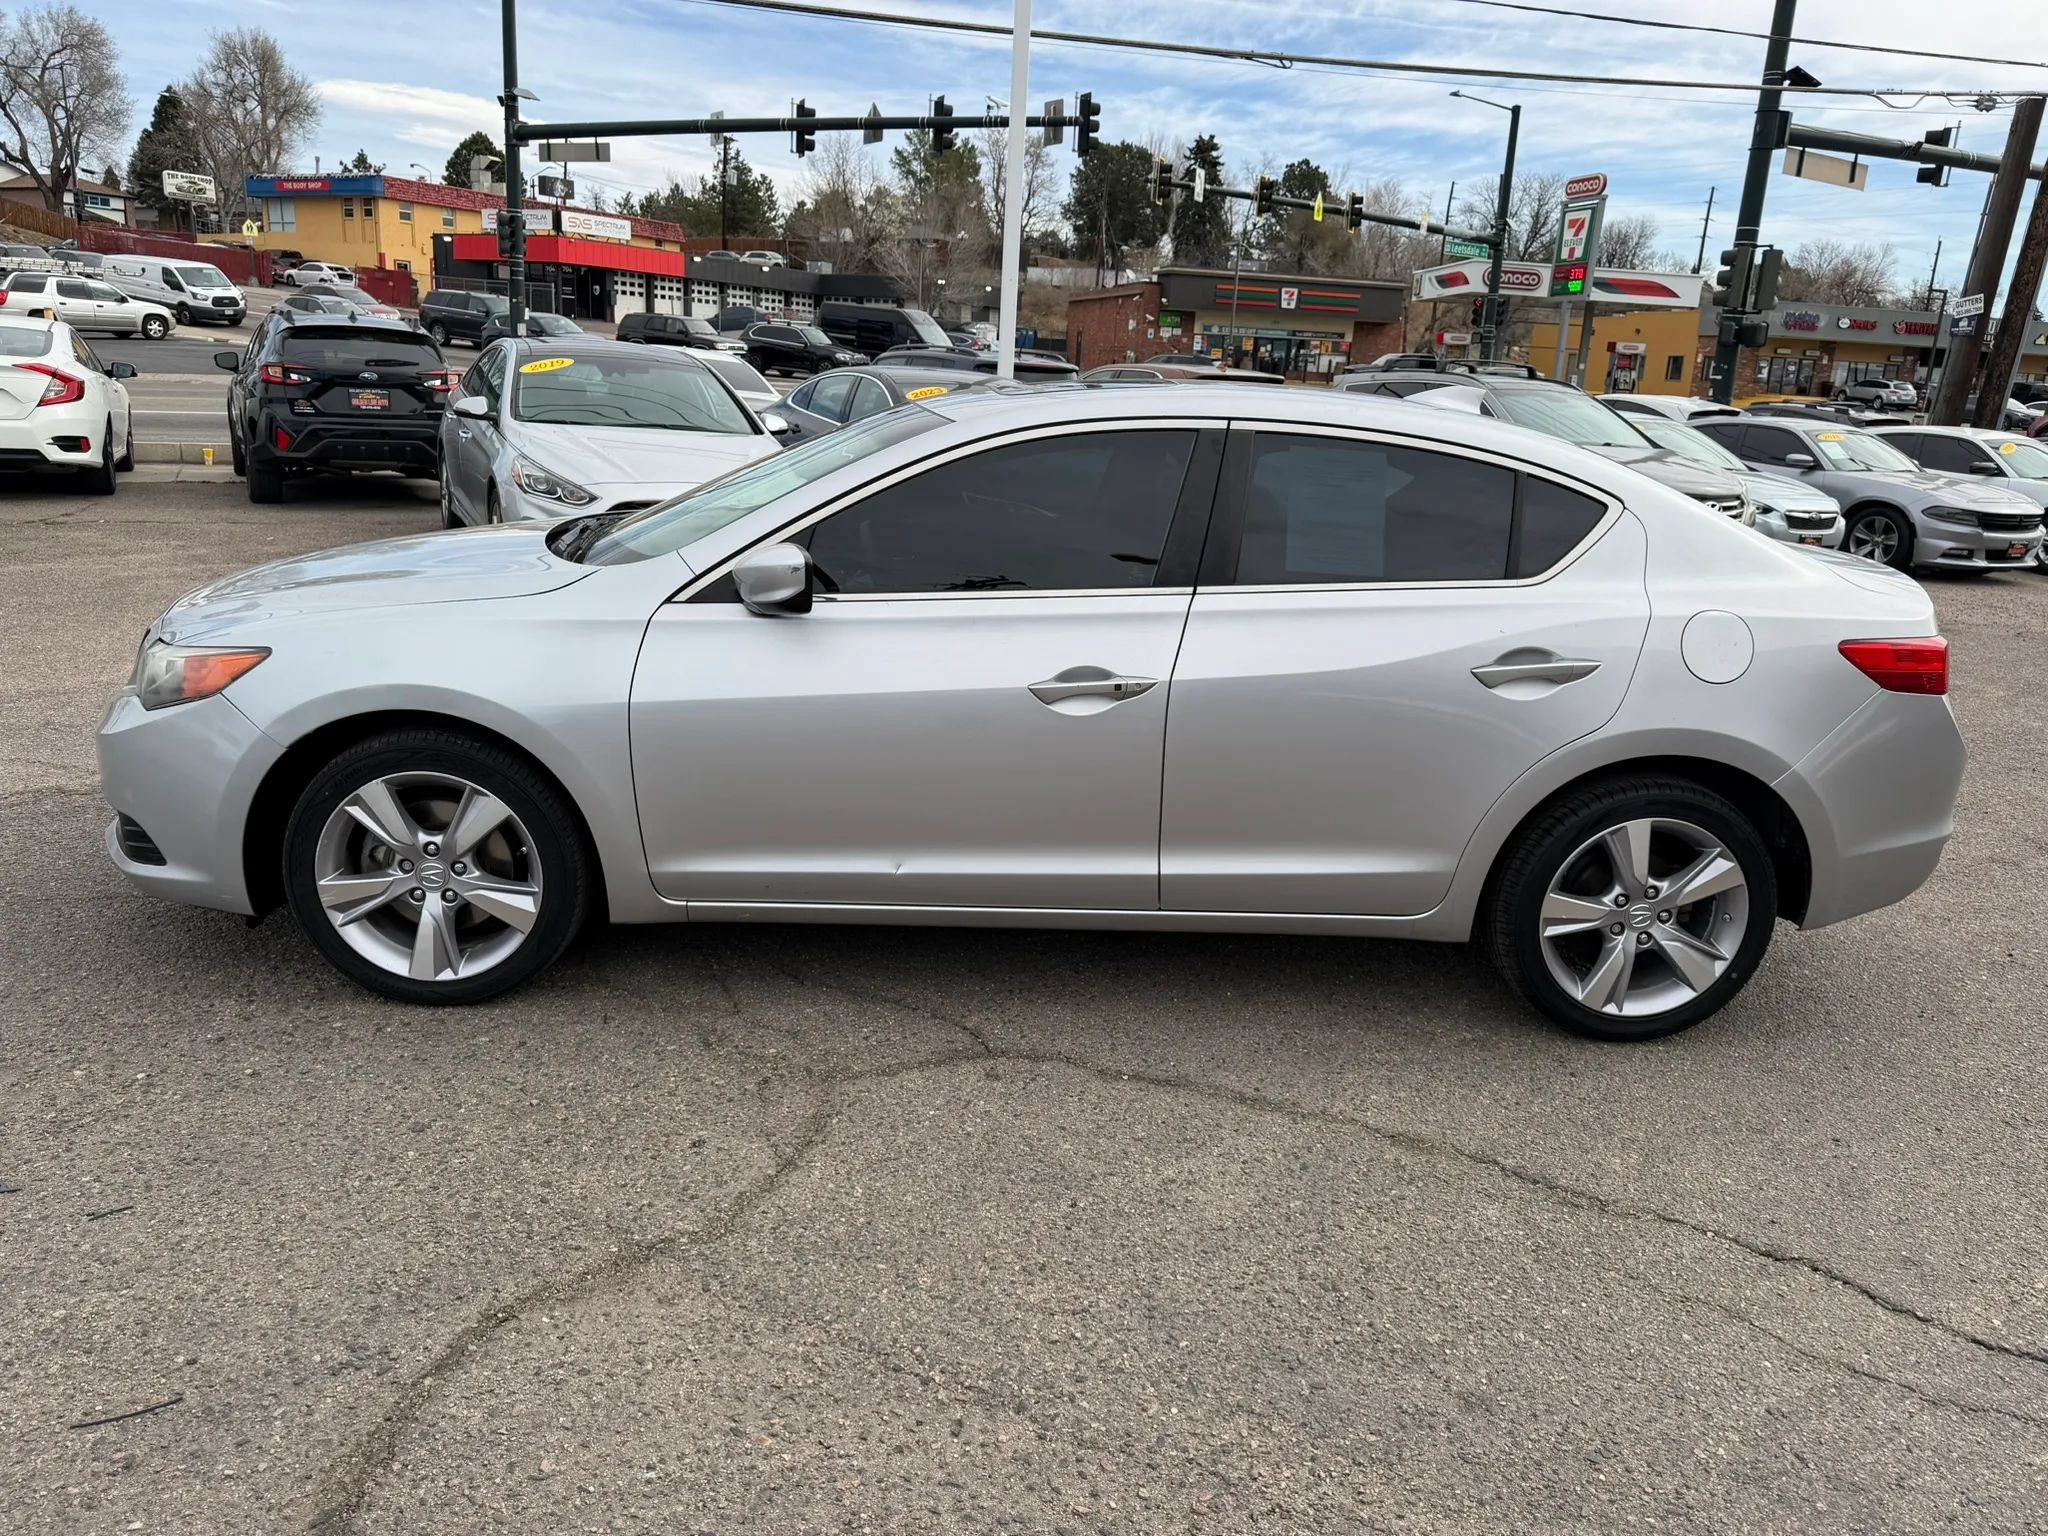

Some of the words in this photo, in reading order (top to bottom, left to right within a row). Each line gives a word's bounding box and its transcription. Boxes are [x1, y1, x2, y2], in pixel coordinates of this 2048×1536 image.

[167, 172, 179, 180] THE
[283, 181, 292, 189] THE
[293, 181, 306, 189] BODY
[308, 181, 322, 189] SHOP
[1451, 243, 1480, 256] Leetsdale
[1955, 297, 1983, 309] GUTTERS
[530, 360, 565, 371] 2019
[911, 387, 944, 399] 2023
